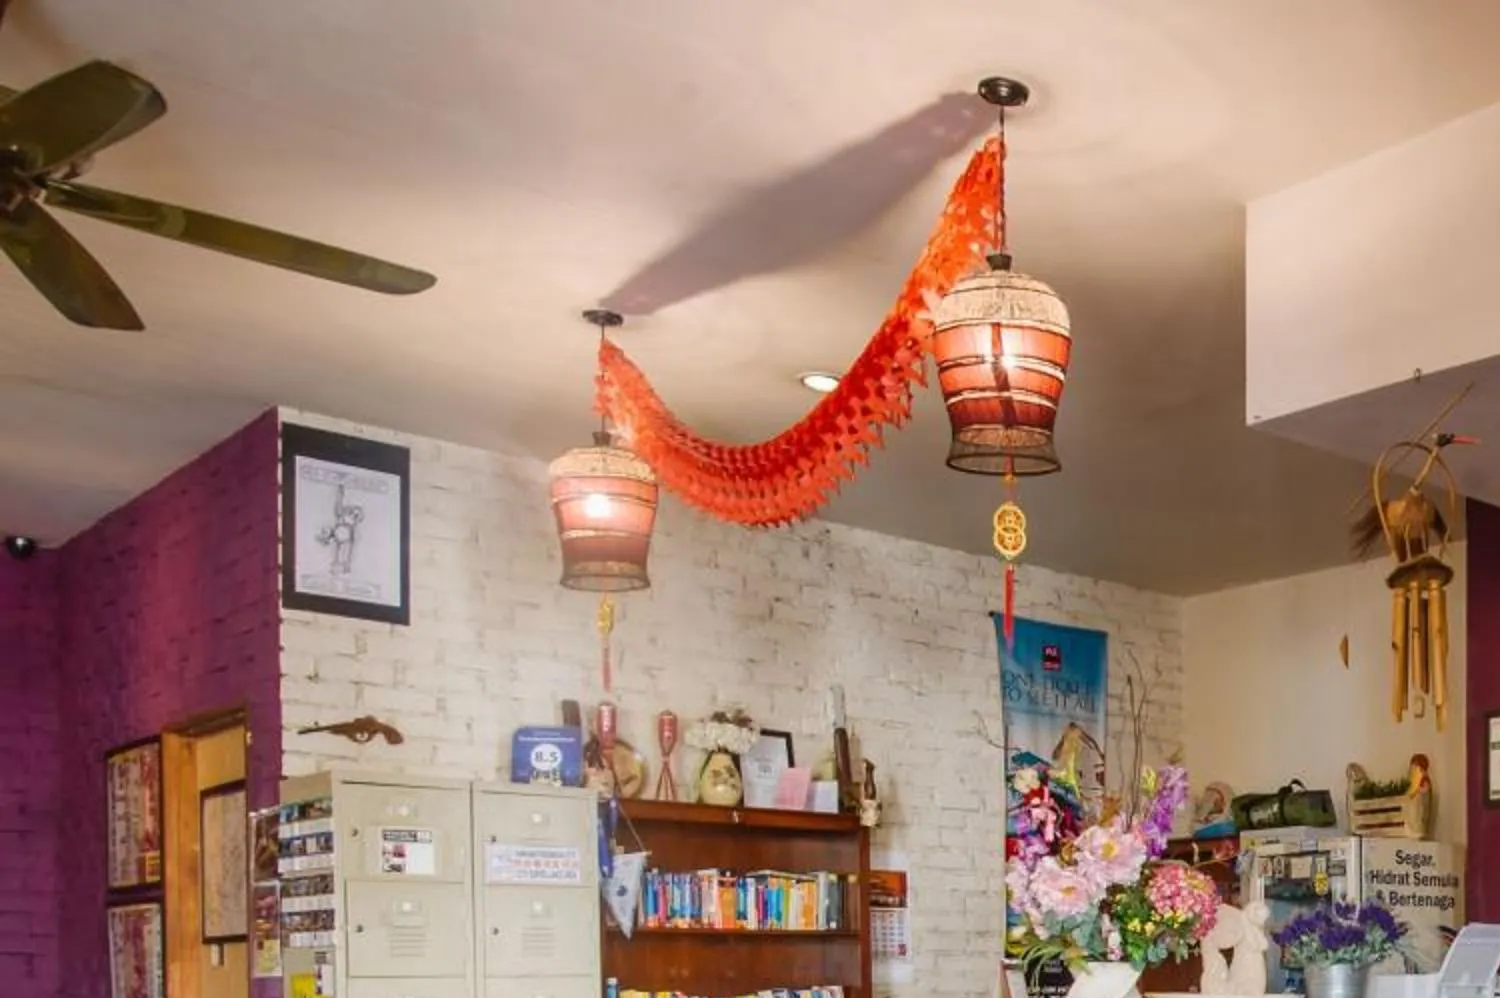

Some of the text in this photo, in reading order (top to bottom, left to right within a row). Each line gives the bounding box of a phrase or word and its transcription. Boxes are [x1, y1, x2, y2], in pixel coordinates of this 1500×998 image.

[534, 751, 558, 763] 8.5
[1369, 869, 1459, 887] Hidrat Semula
[1389, 891, 1456, 911] Bertenaga
